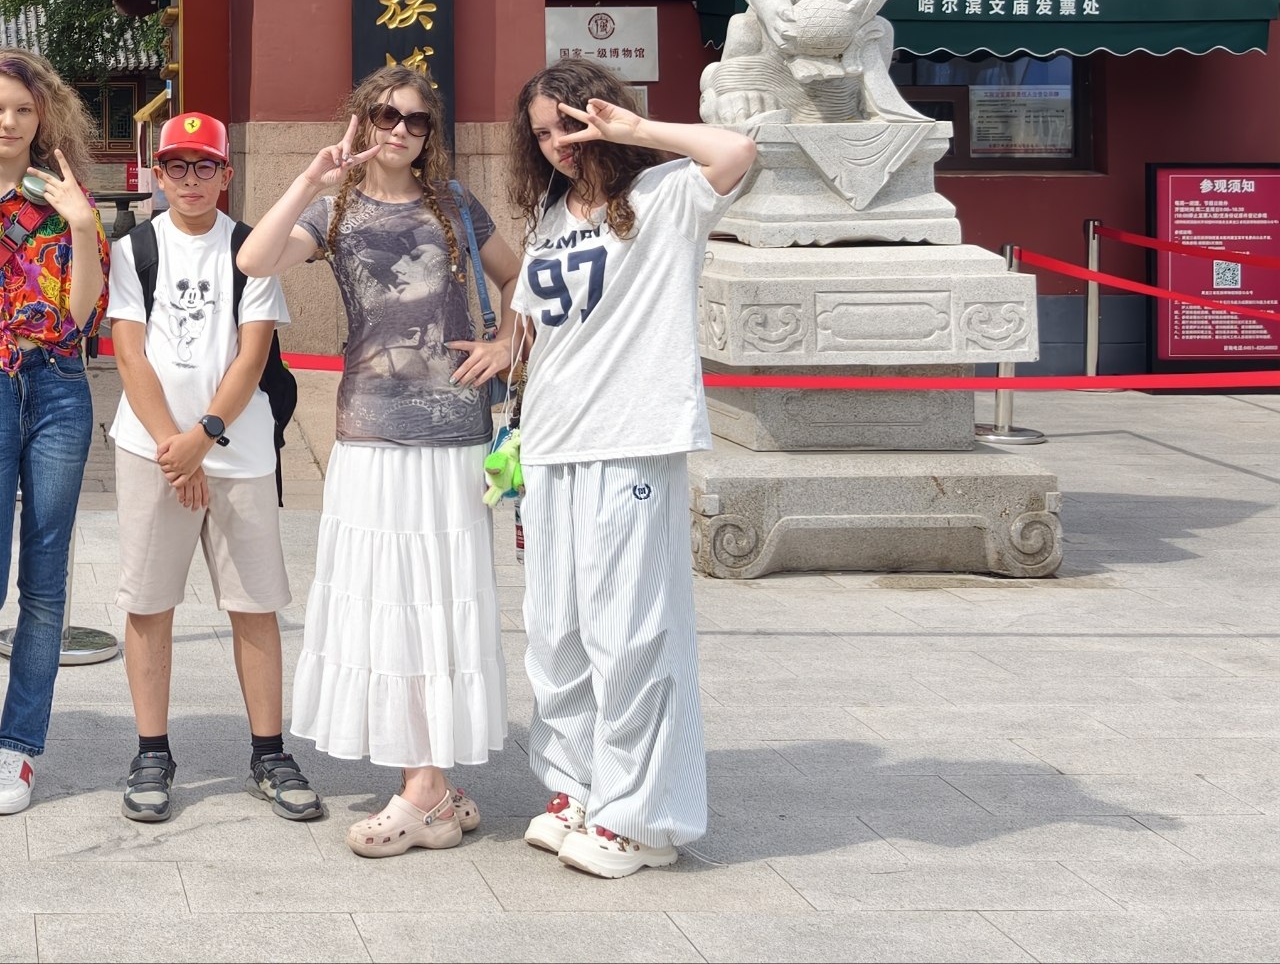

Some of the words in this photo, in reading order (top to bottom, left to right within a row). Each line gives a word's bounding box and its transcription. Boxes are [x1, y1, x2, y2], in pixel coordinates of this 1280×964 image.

[559, 47, 645, 58] 国家一级博物馆
[1200, 179, 1255, 193] 参观须知
[527, 245, 608, 327] 97
